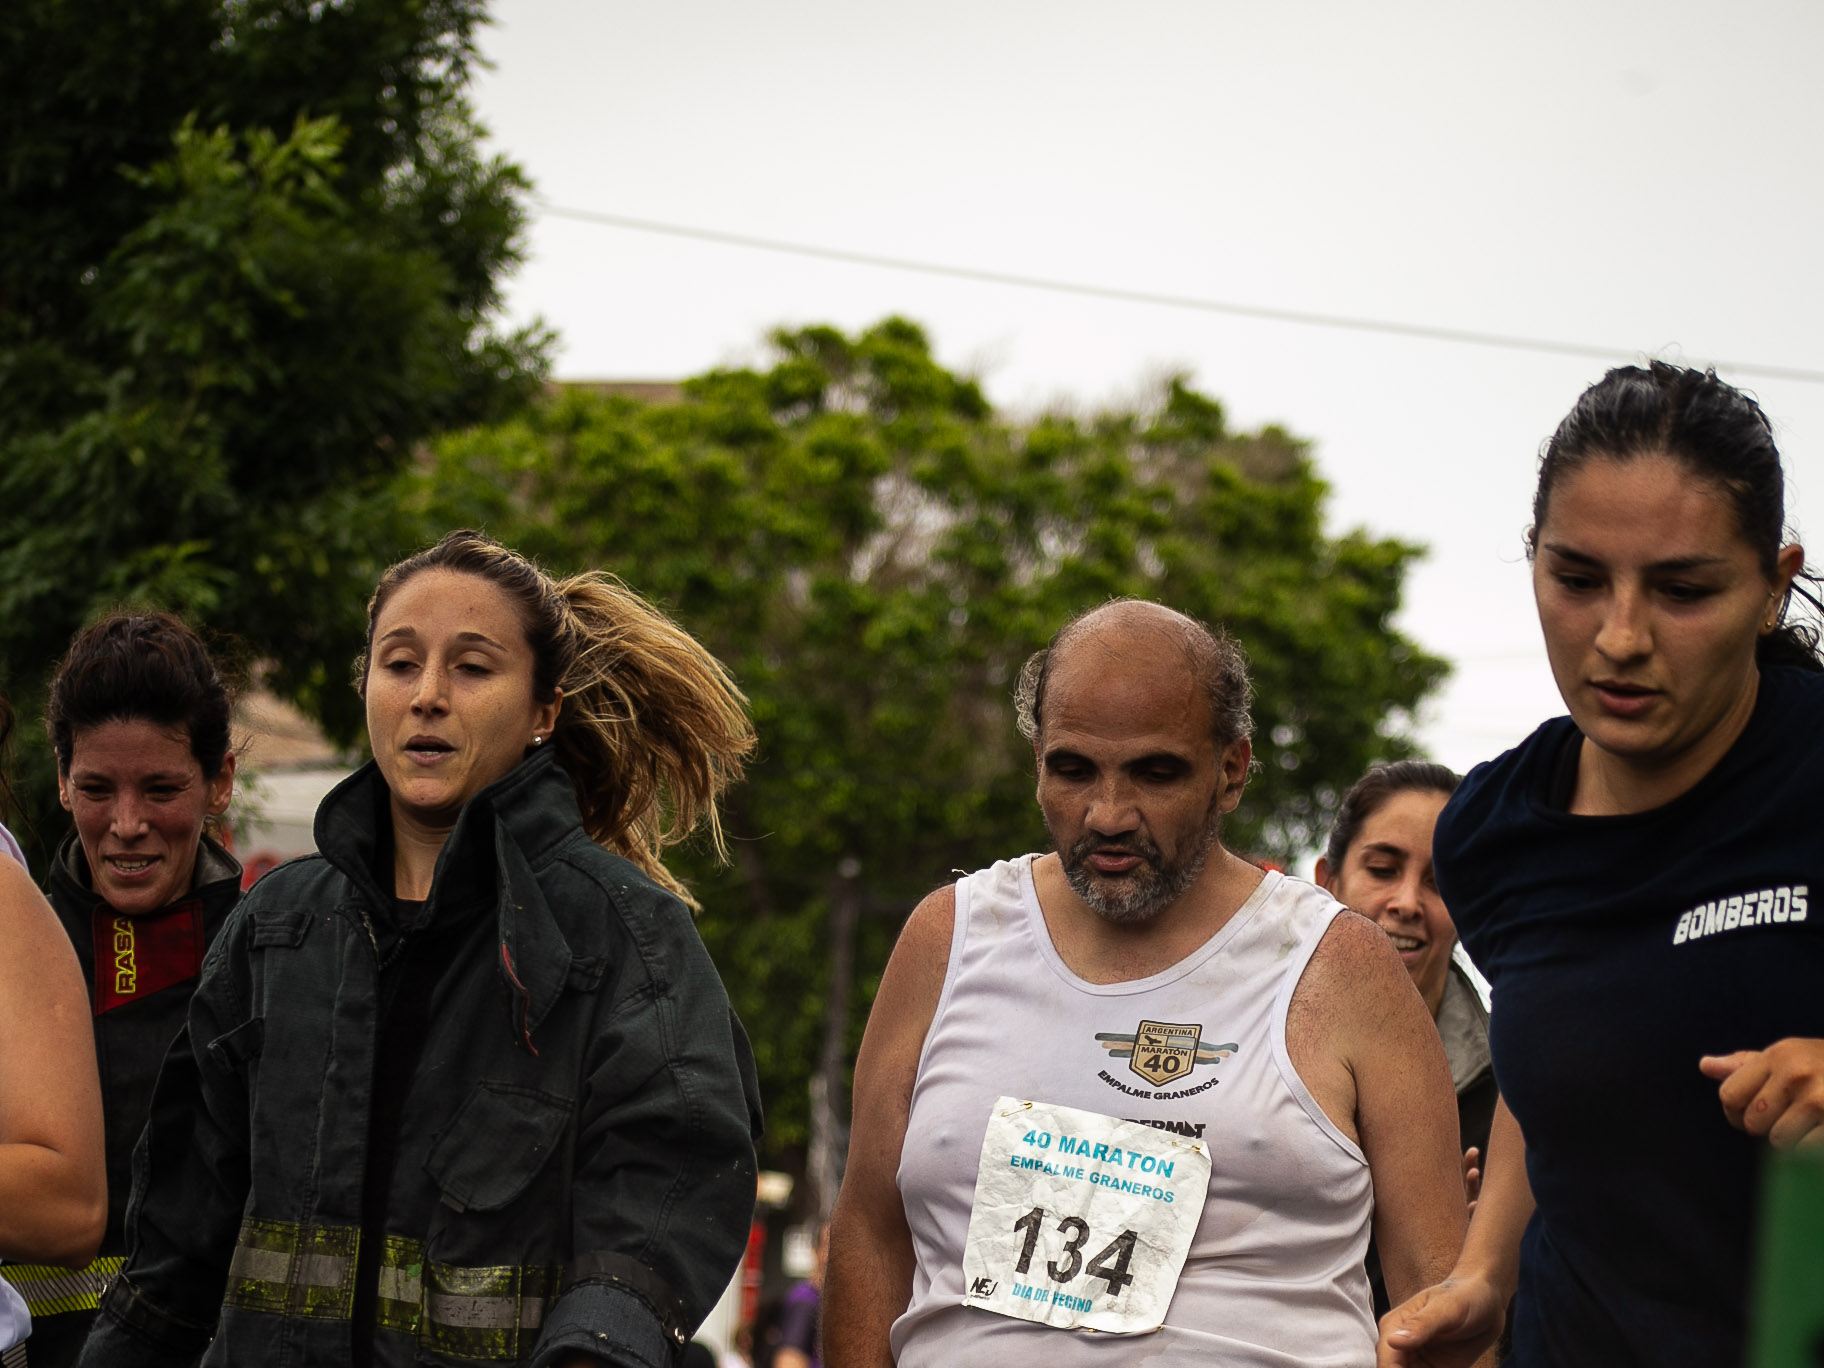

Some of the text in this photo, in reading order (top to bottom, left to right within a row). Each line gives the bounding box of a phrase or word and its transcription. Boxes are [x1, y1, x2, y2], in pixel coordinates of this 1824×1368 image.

[1673, 885, 1808, 945] BOMBEROS
[113, 915, 136, 994] RASA
[1145, 1026, 1193, 1037] ARGENTINA
[1141, 1046, 1188, 1057] MARATÓN
[1143, 1055, 1181, 1074] 40
[1097, 1070, 1220, 1100] EMPALME GRANEROS
[1023, 1130, 1175, 1178] 40 MARATON
[1010, 1155, 1175, 1203] EMPALME GRANEROS
[1013, 1207, 1139, 1297] 134
[1012, 1283, 1032, 1301] DIA
